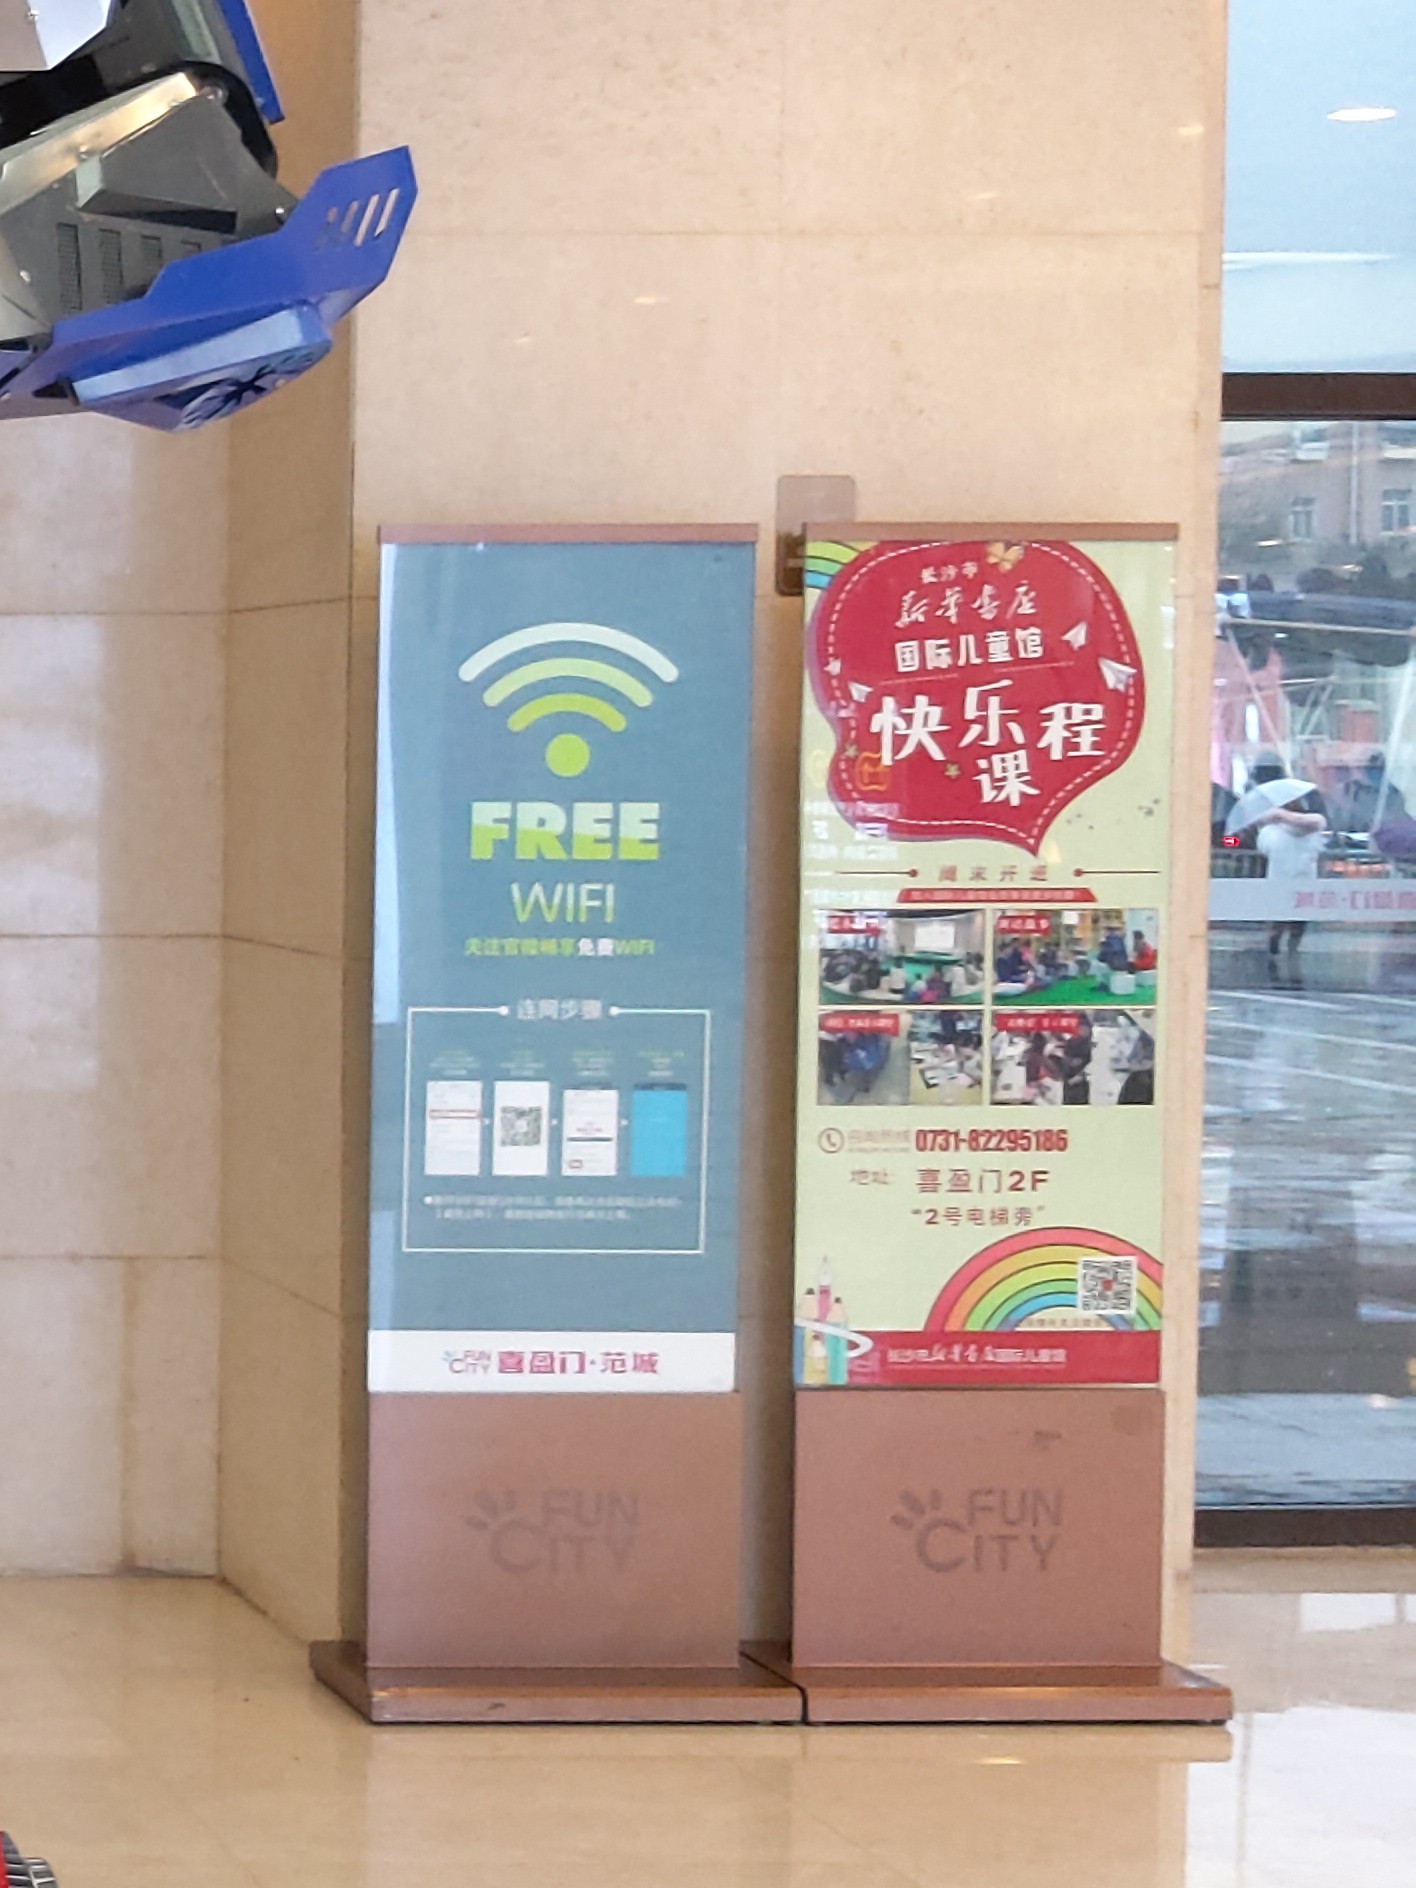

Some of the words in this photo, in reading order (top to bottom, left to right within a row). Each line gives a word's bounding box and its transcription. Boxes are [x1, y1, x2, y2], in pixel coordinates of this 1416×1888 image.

[921, 561, 978, 584] 长沙市
[895, 580, 1037, 628] 新华书店
[895, 627, 1043, 673] 国际儿童馆
[470, 801, 660, 860] FREE
[511, 882, 615, 923] WIFI
[915, 1128, 1068, 1153] 0731-82295186
[540, 1491, 641, 1528] FUN
[969, 1489, 1063, 1527] FUN
[489, 1517, 635, 1575] CITY
[916, 1517, 1061, 1573] CITY
